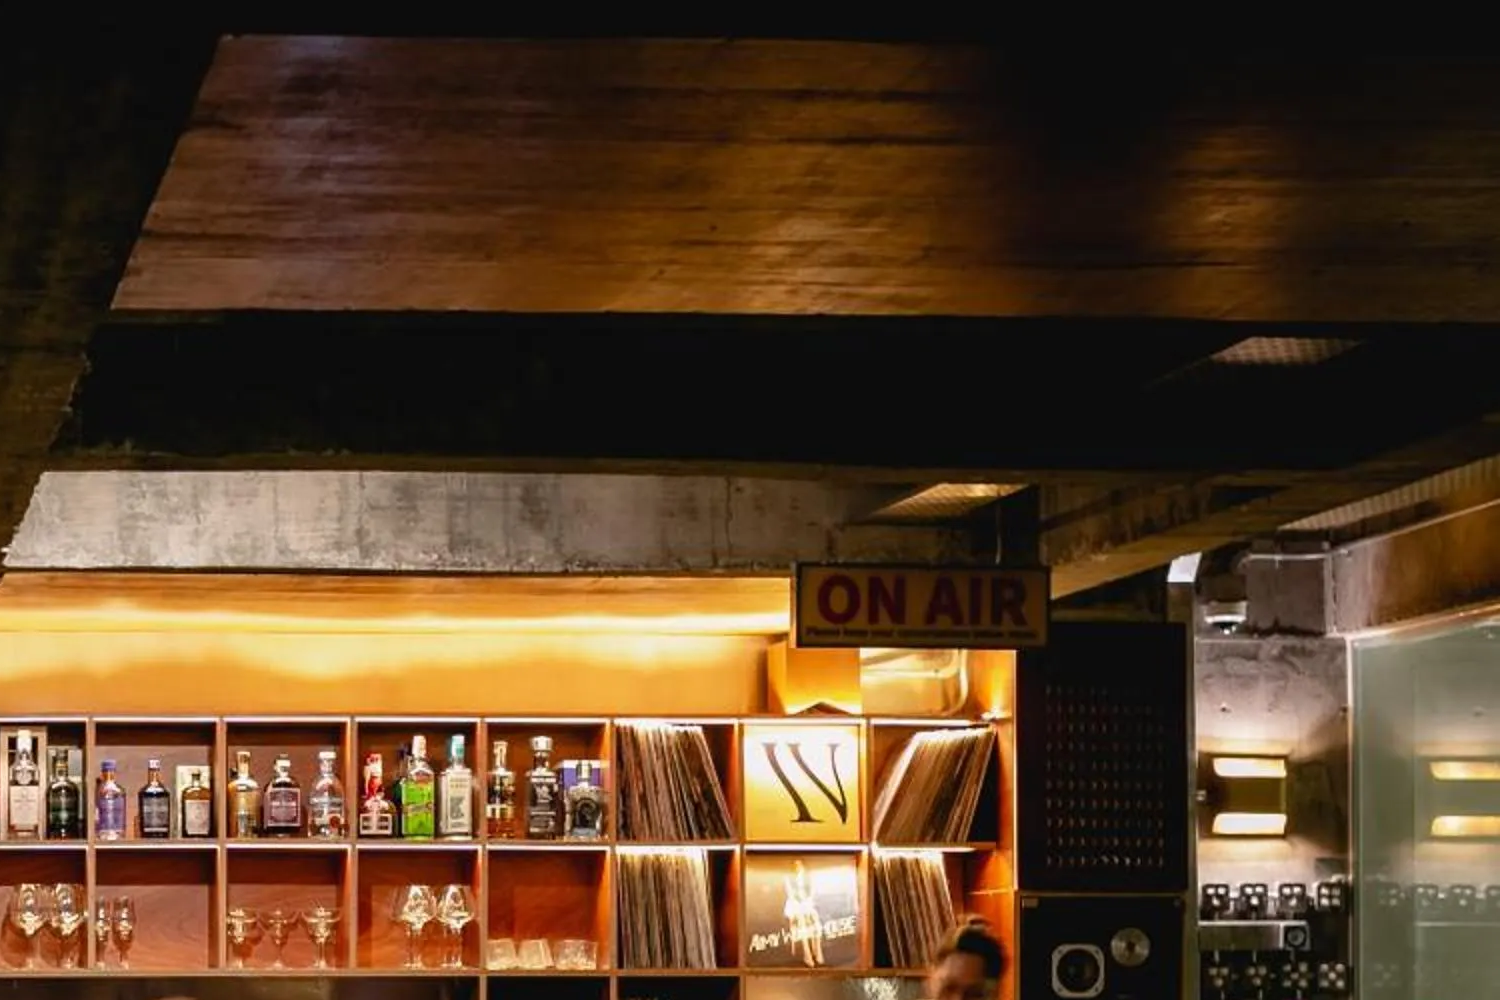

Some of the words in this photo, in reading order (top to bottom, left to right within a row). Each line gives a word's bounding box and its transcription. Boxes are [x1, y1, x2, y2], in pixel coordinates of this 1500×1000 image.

[817, 574, 906, 625] ON
[925, 575, 1028, 626] AIR
[749, 930, 780, 953] AMY
